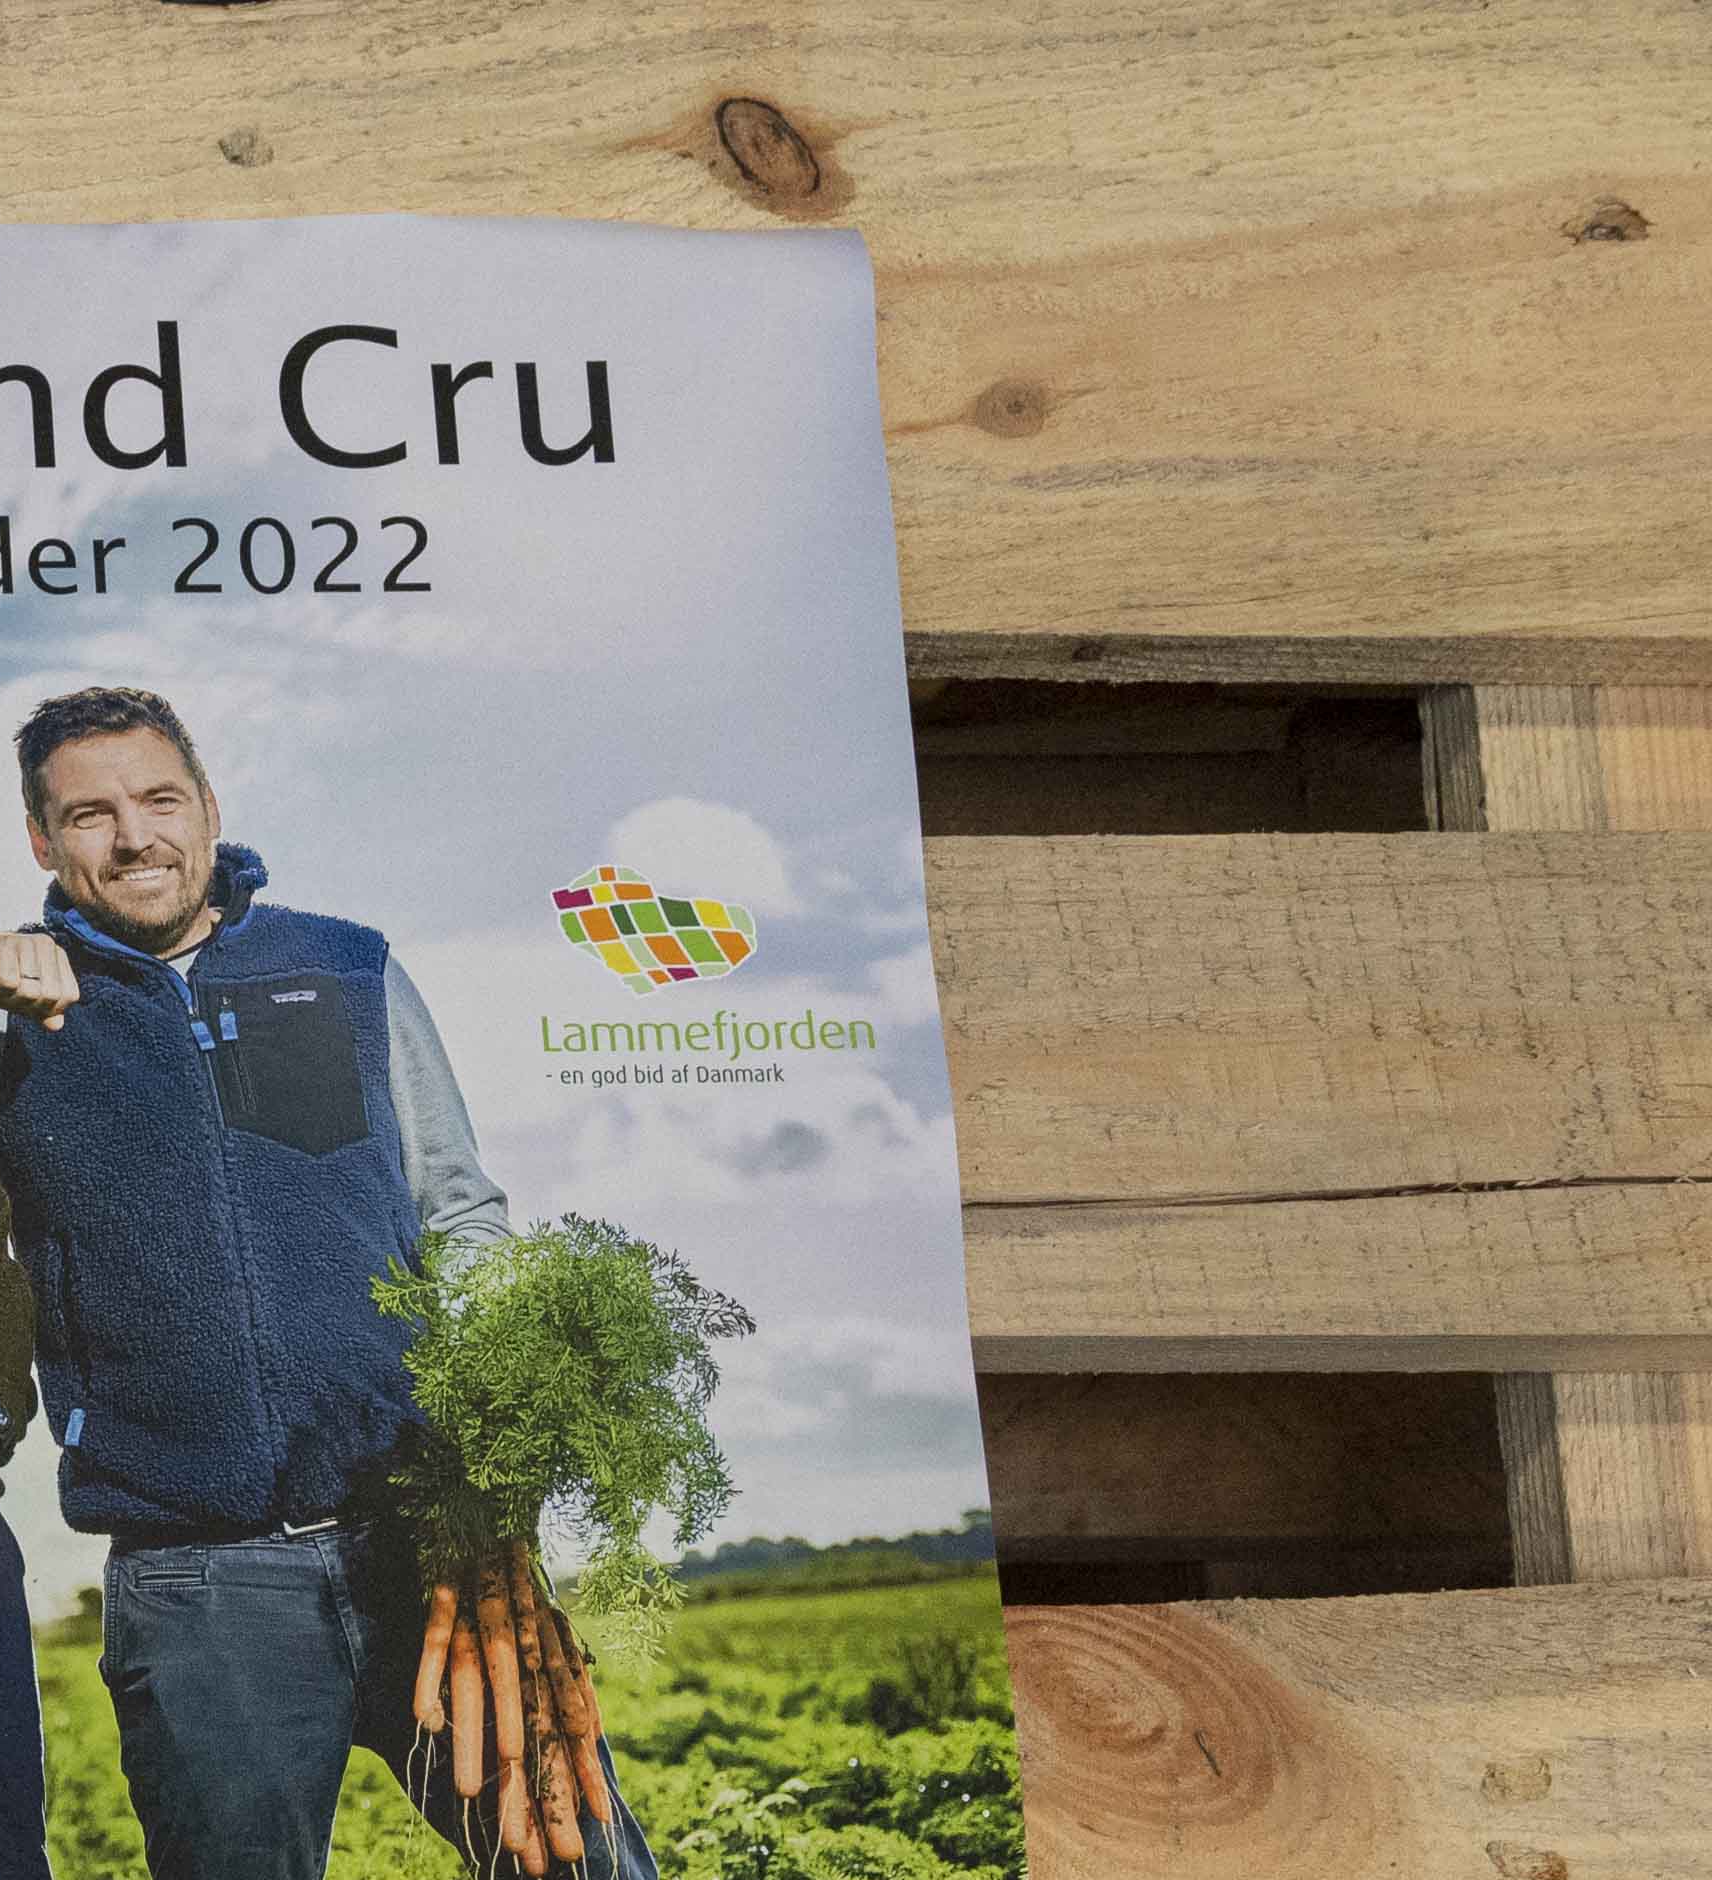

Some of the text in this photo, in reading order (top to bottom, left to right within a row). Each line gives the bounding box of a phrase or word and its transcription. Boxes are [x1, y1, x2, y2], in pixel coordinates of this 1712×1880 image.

[278, 323, 616, 469] Cru
[172, 516, 433, 594] 2022
[541, 1008, 877, 1061] Lammefjorden
[560, 1069, 584, 1085] en
[591, 1064, 626, 1089] god
[634, 1064, 663, 1085] bid
[671, 1063, 689, 1084] af
[696, 1063, 785, 1084] Danmark
